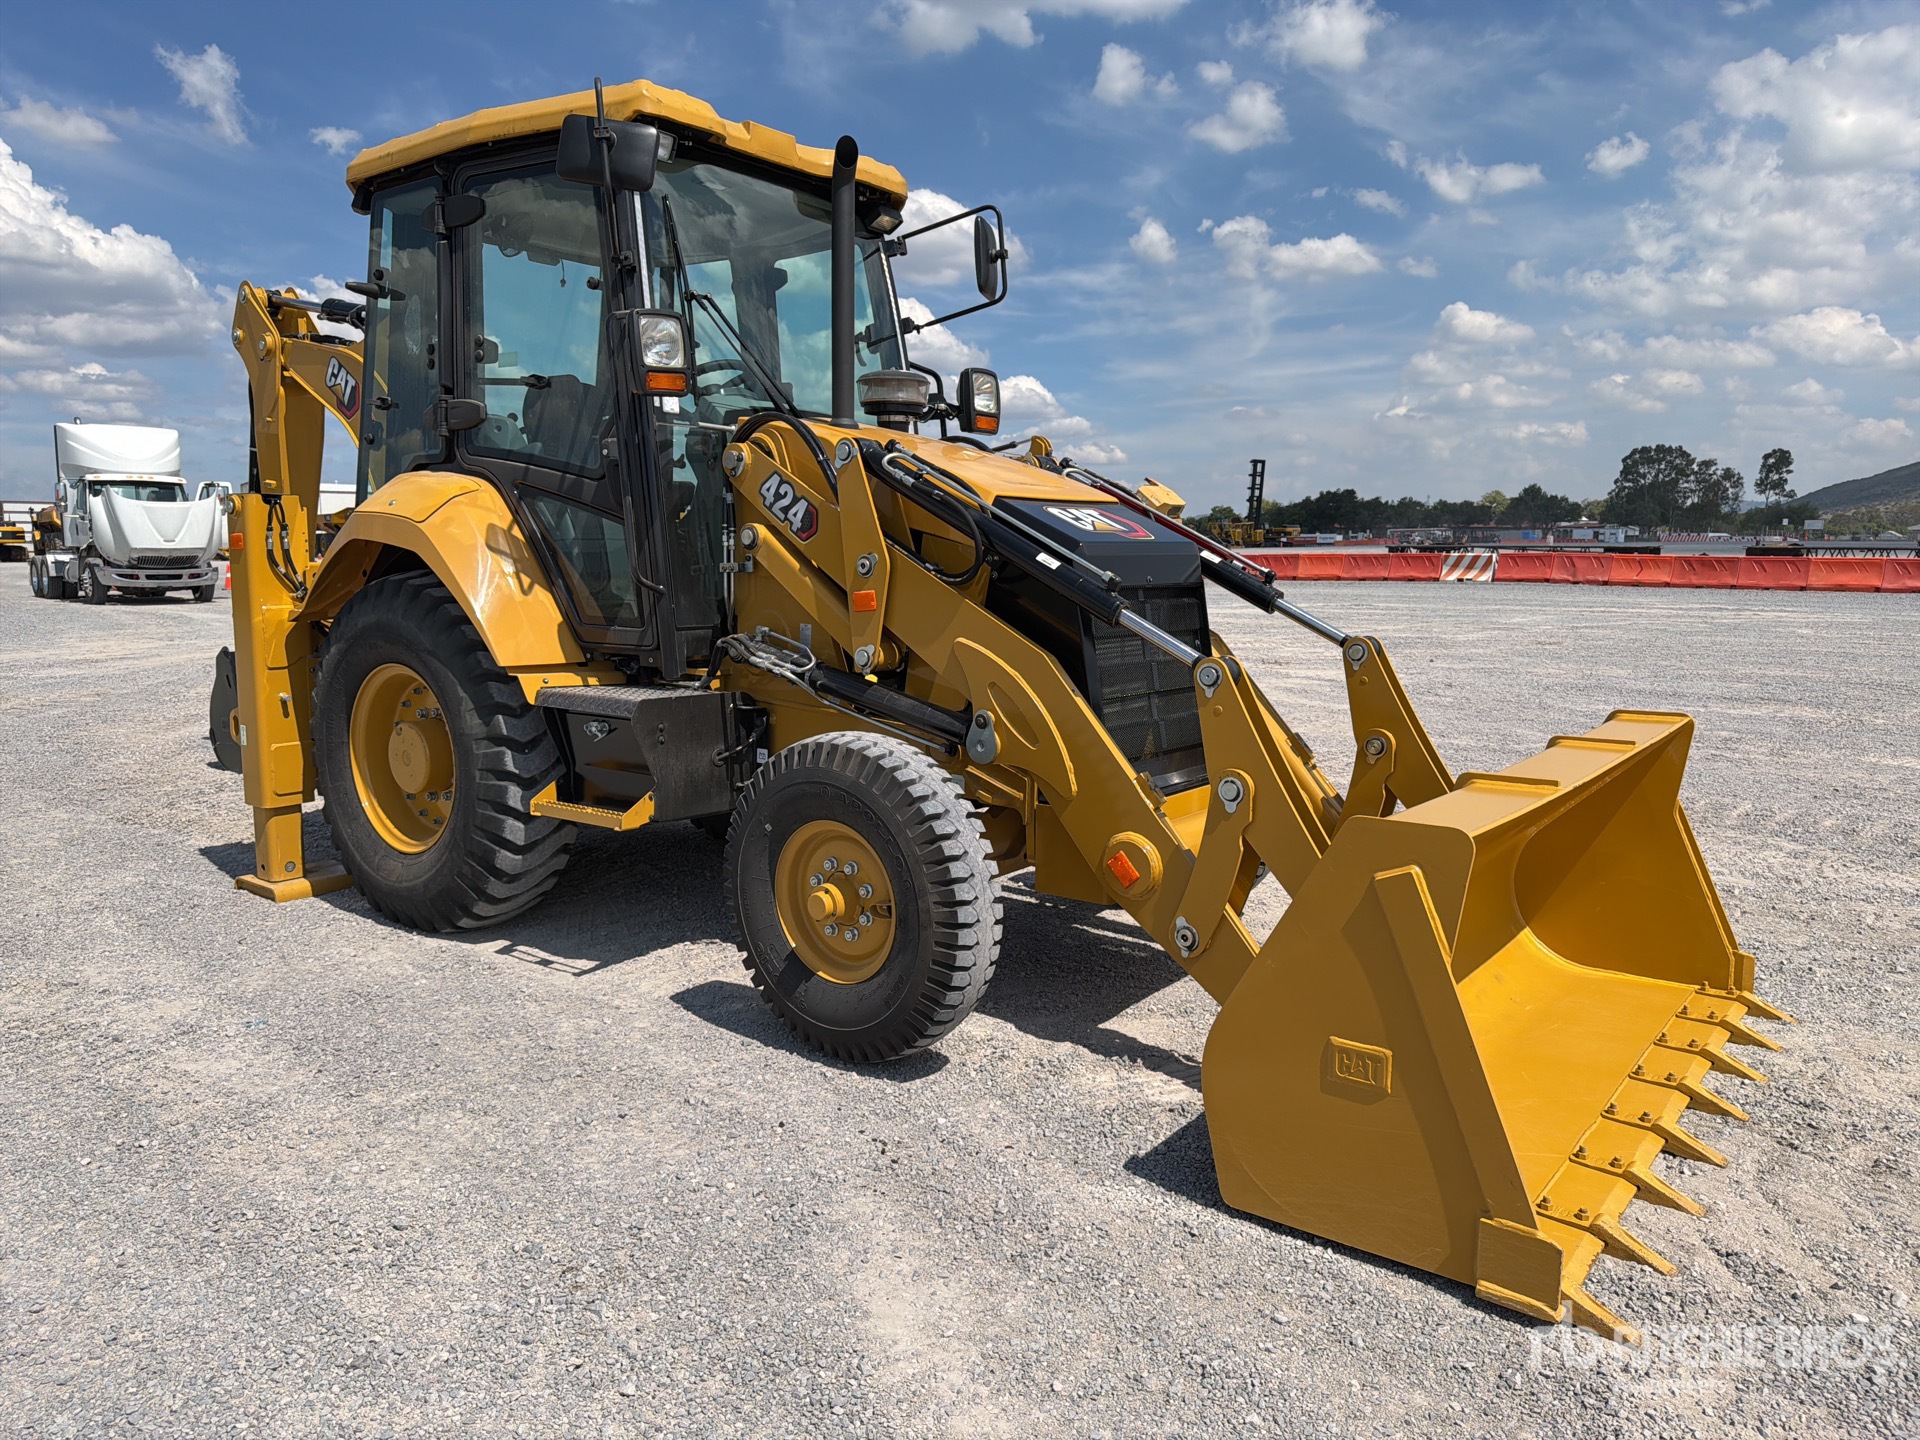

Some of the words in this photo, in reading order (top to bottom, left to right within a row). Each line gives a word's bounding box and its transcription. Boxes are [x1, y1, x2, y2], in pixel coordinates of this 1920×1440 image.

[326, 357, 356, 406] CAT
[760, 473, 809, 533] 424
[1045, 507, 1129, 532] CAT
[839, 791, 904, 870] APOLLO
[1336, 1051, 1381, 1086] CAT
